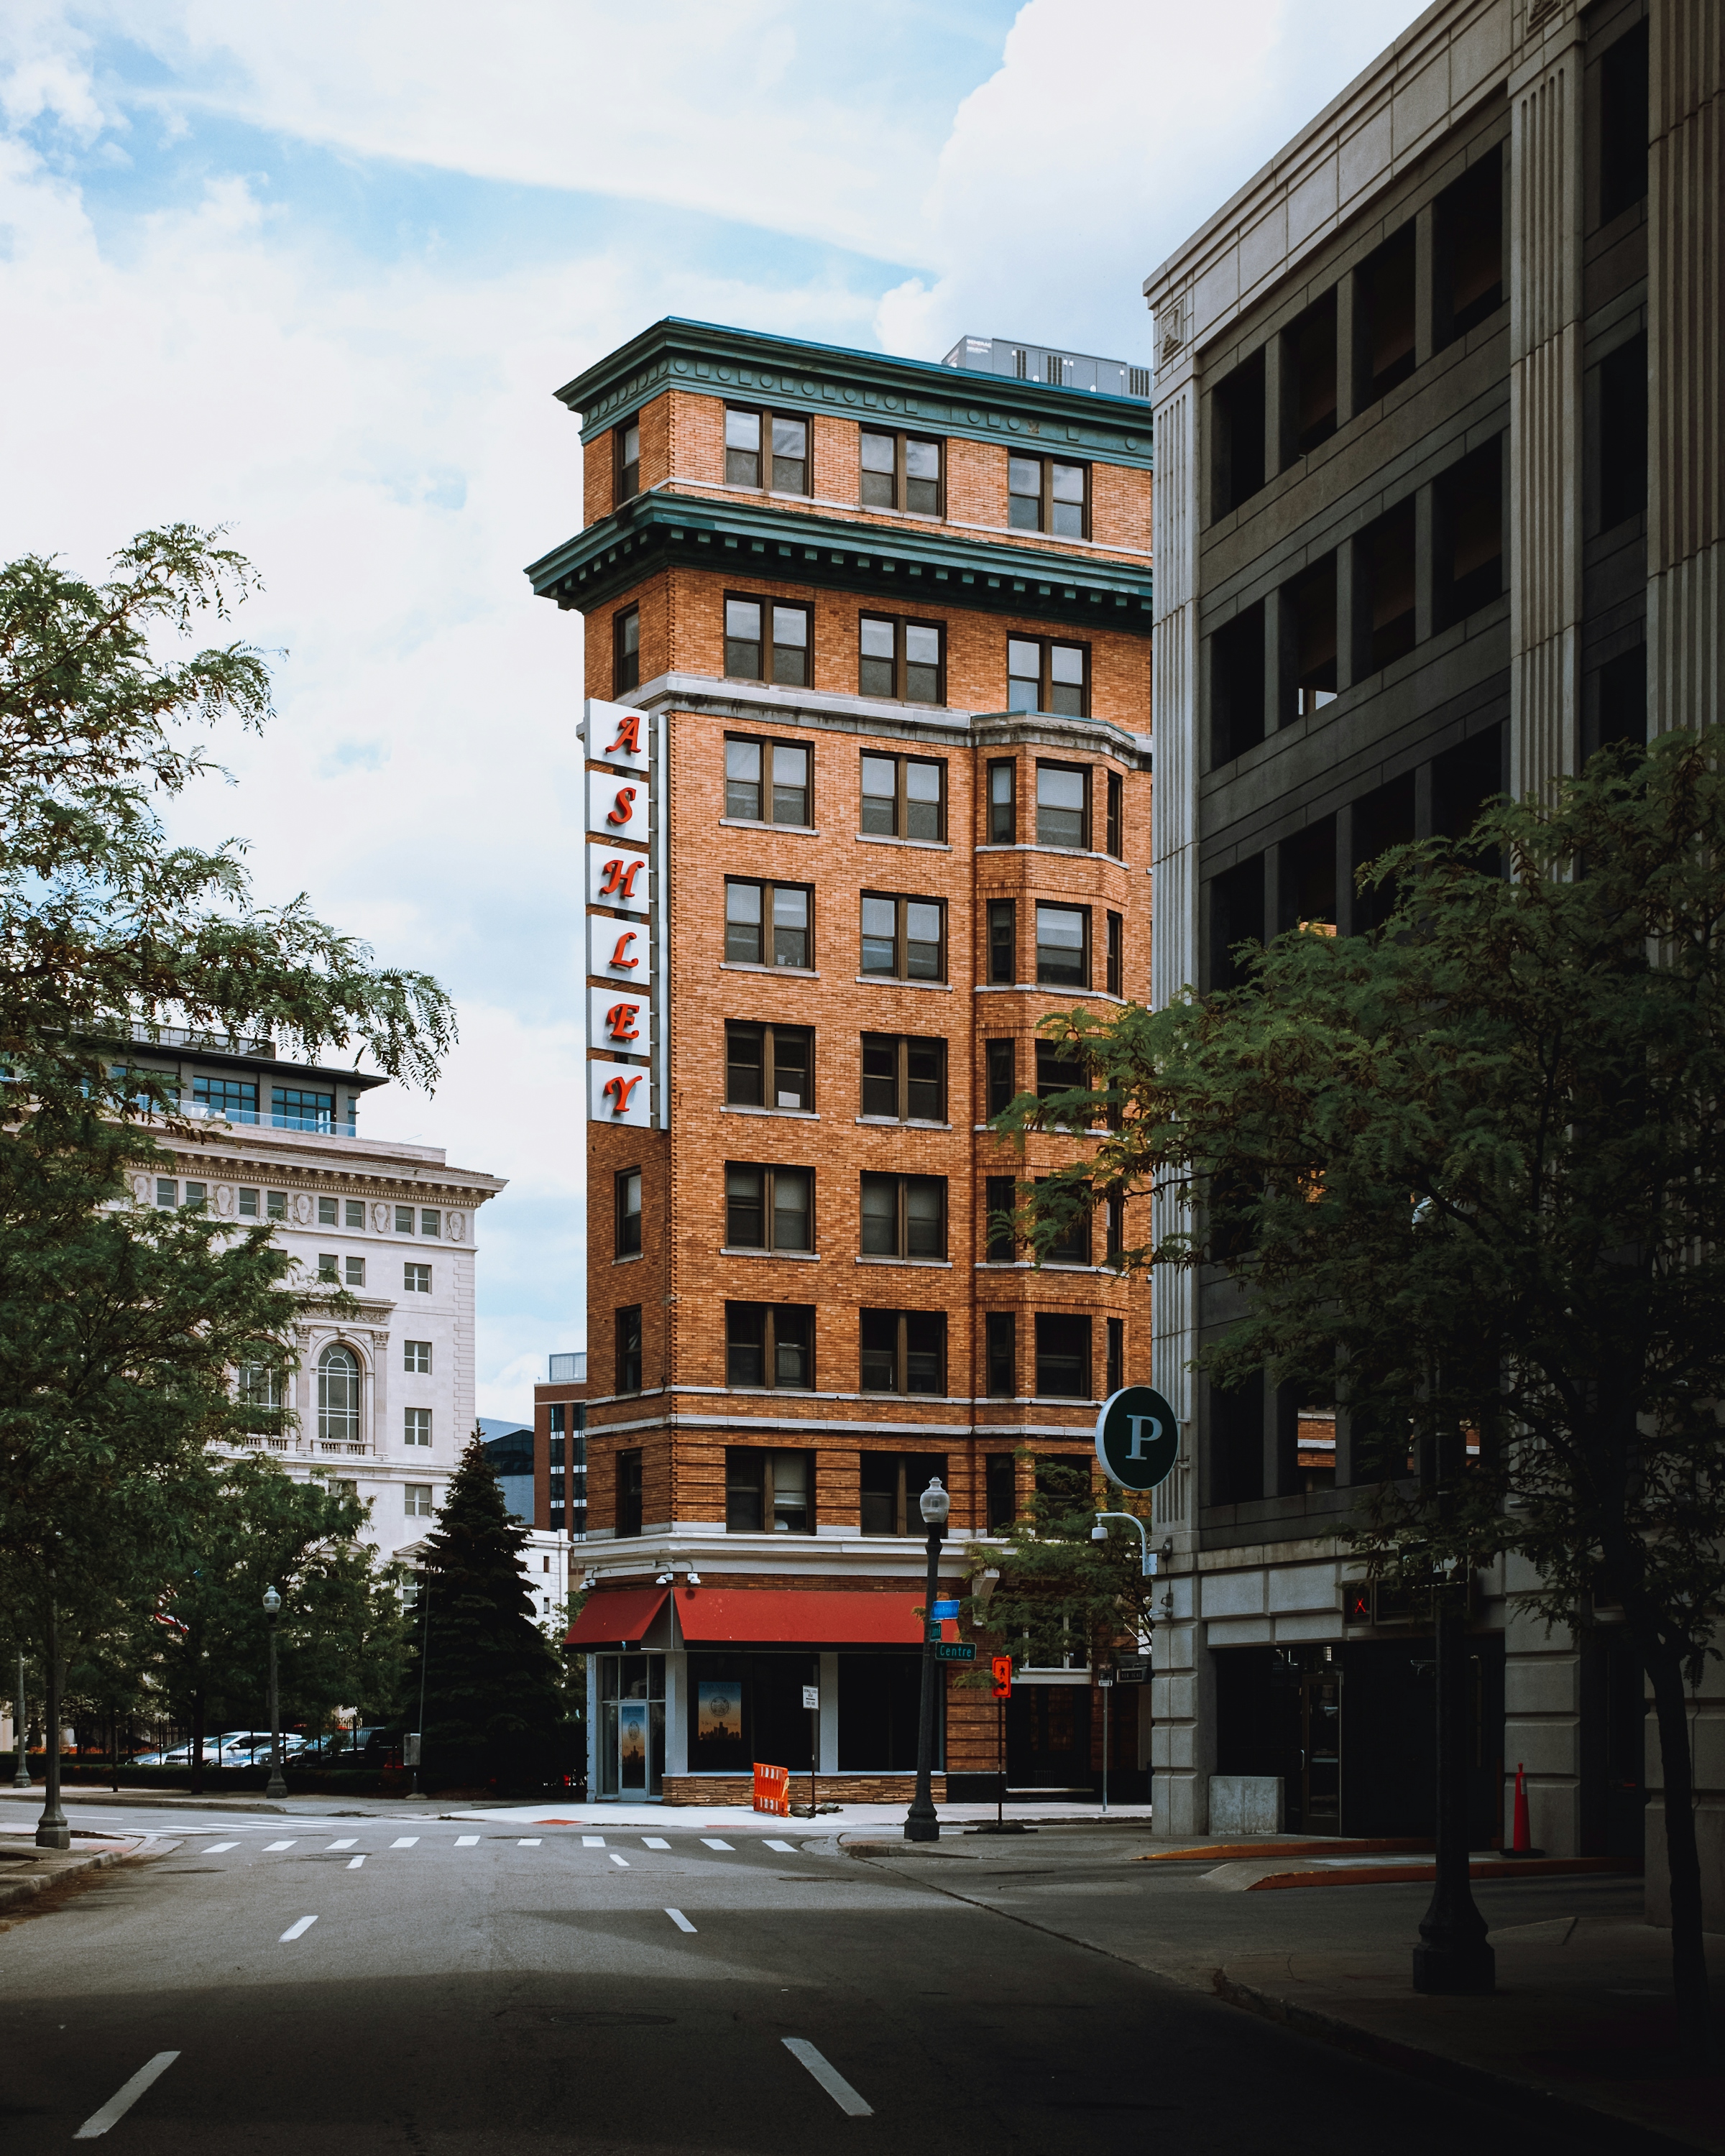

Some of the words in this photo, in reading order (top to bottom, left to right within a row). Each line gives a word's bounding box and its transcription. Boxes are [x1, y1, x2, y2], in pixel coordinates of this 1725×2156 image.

[603, 717, 644, 1110] ASHLEY
[1126, 1414, 1163, 1460] P
[940, 1645, 972, 1657] Centre
